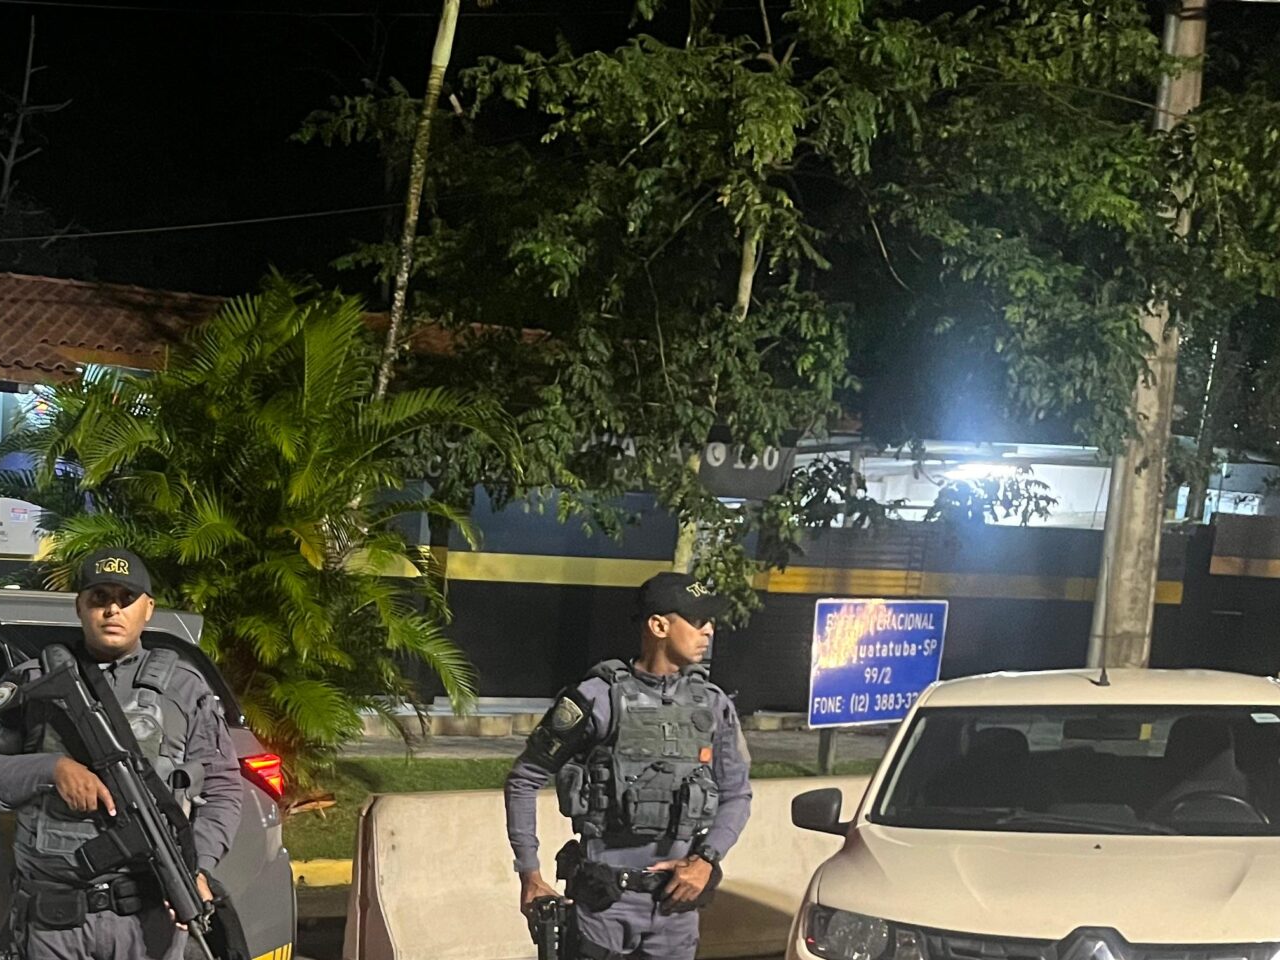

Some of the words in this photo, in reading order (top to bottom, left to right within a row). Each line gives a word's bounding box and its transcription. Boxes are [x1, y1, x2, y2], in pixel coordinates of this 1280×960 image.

[95, 557, 129, 575] TOR
[863, 667, 892, 684] 99/2
[813, 695, 846, 714] FONE:
[850, 692, 870, 714] (12)
